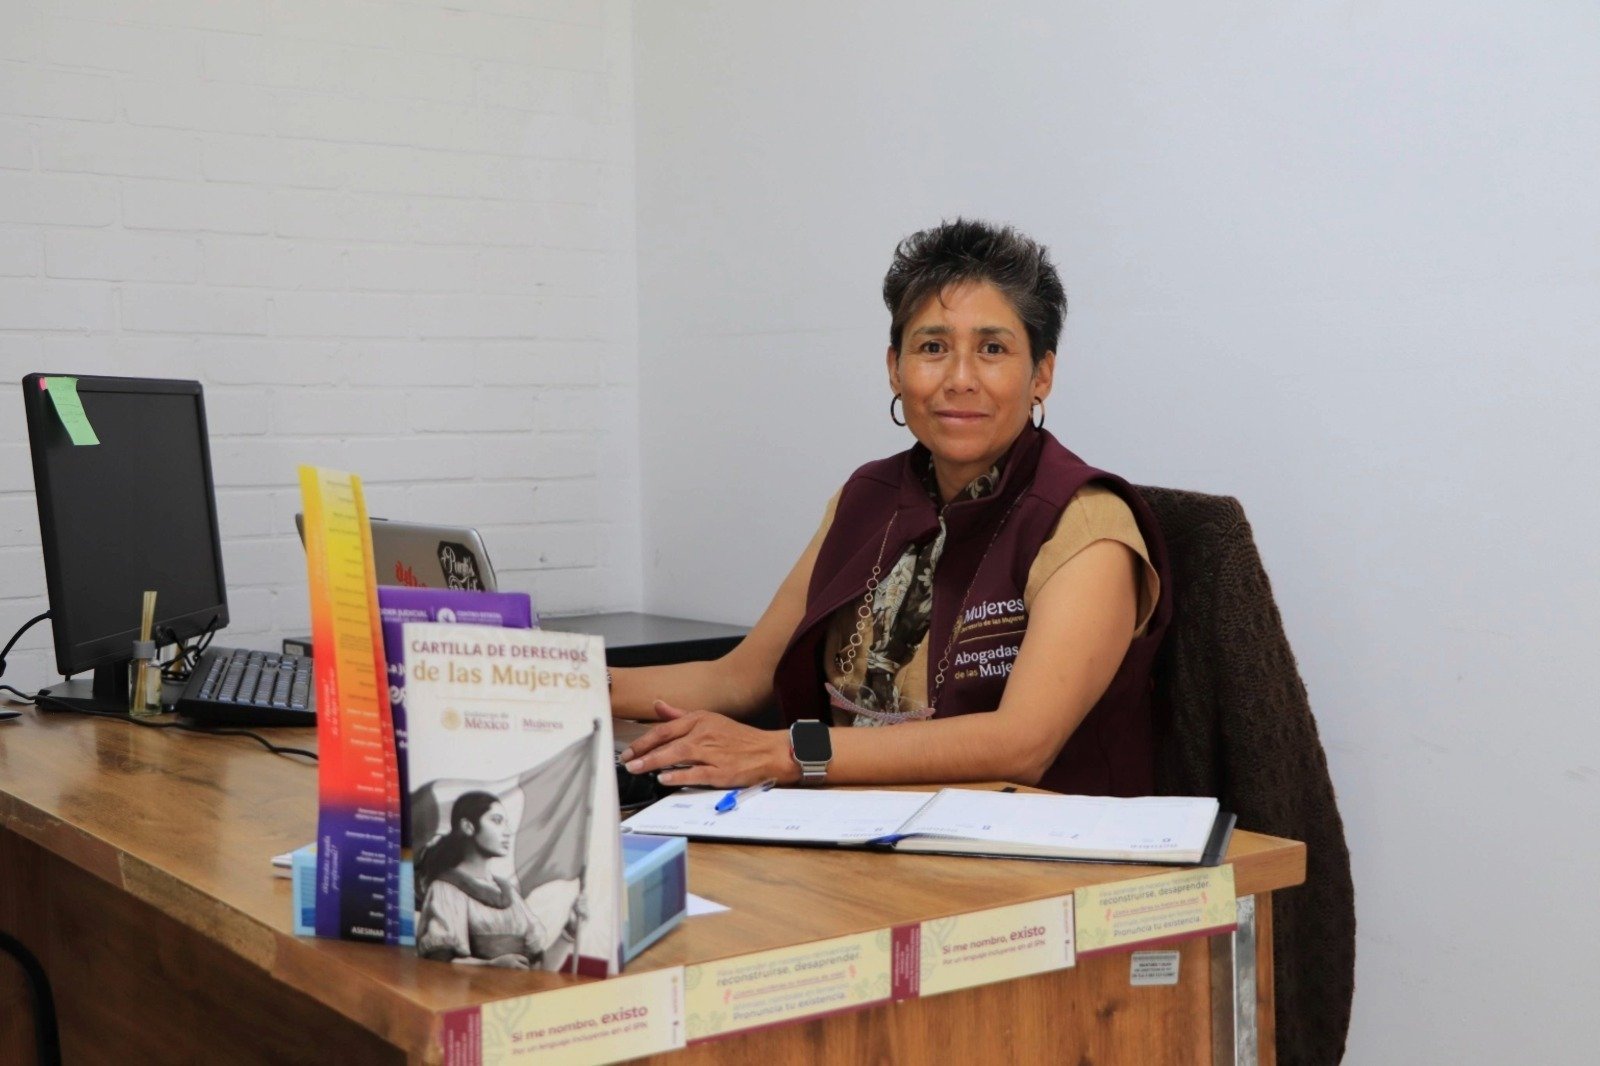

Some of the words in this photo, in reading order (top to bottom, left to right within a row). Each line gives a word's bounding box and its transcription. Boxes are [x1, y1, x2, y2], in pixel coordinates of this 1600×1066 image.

[964, 598, 1024, 623] Mujeres
[412, 640, 482, 656] CARTILLA
[487, 645, 504, 657] DE
[512, 645, 588, 662] DERECHOS
[955, 645, 1019, 665] Abogadas
[413, 660, 439, 681] de
[449, 663, 482, 684] las
[492, 664, 591, 691] Mujeres
[955, 670, 965, 679] de
[966, 668, 978, 677] las
[464, 717, 509, 730] México
[522, 718, 564, 731] Mujeres
[1100, 890, 1156, 906] reconstruirse,
[352, 926, 384, 937] ASESINAR
[1114, 925, 1152, 937] Pronuncia
[1154, 922, 1162, 930] tu
[943, 945, 951, 955] Si
[953, 942, 968, 952] me
[970, 935, 1008, 949] nombro,
[1010, 926, 1046, 941] existo
[733, 1005, 783, 1021] Pronuncia
[786, 1002, 794, 1010] tu
[512, 1031, 523, 1043] Si
[526, 1028, 545, 1040] me
[549, 1016, 597, 1035] nombro,
[601, 1004, 648, 1025] existo
